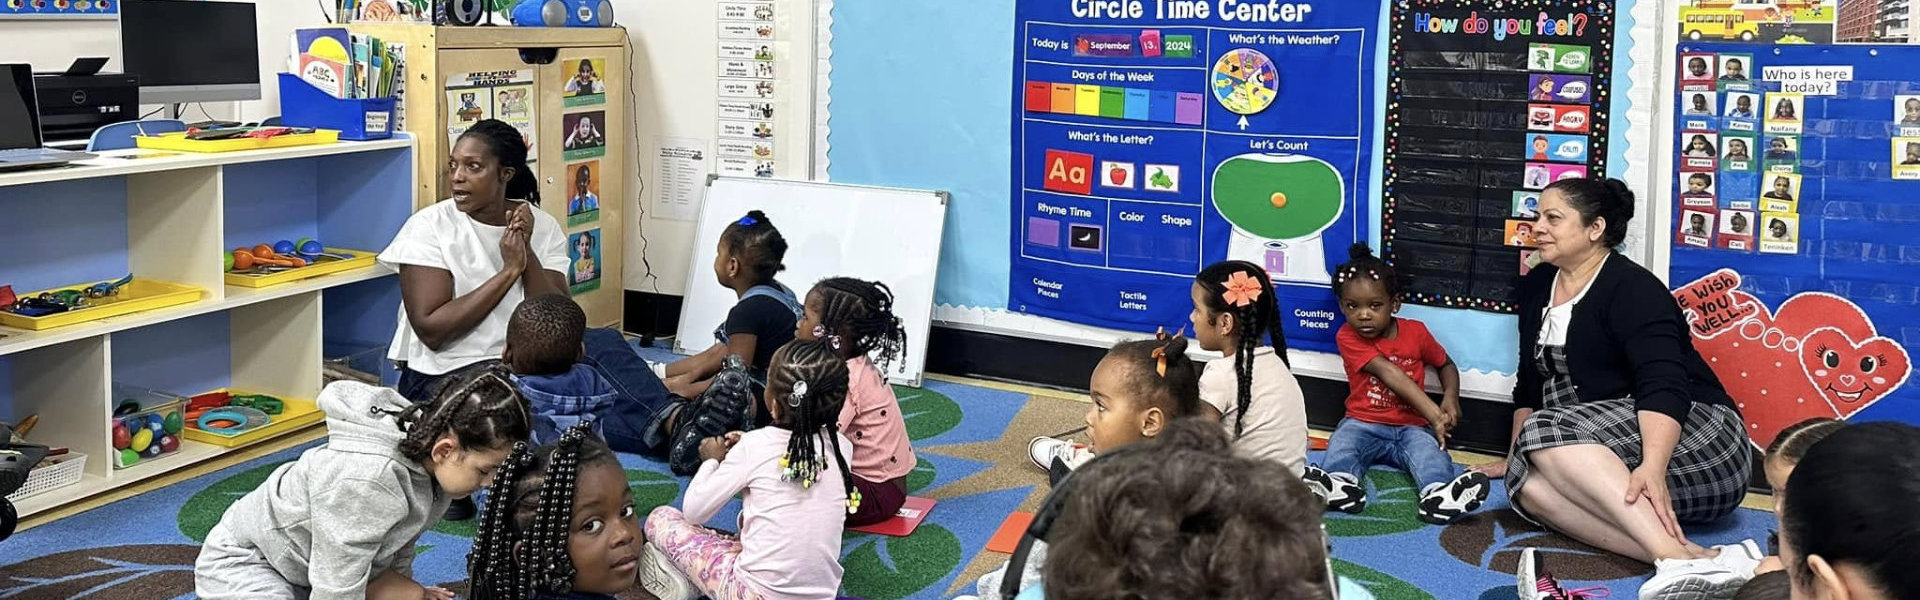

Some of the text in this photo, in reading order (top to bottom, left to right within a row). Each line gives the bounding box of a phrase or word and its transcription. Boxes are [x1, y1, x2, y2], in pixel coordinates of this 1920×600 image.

[1071, 0, 1312, 22] Circle Time Center
[1415, 11, 1588, 41] How do you feel?
[1032, 38, 1059, 51] Today
[1061, 40, 1069, 49] is
[1090, 41, 1131, 51] September
[1165, 41, 1191, 50] 2024
[1229, 34, 1340, 45] What's the Weather?
[468, 70, 517, 78] HELPING
[1072, 70, 1154, 82] Days of the Week
[1764, 68, 1848, 80] Who is here
[473, 78, 511, 86] HANDS
[1785, 82, 1832, 94] today?
[1068, 131, 1154, 145] What's the Letter?
[1903, 128, 1920, 136] Jes
[1250, 139, 1309, 151] Let's Count
[1048, 157, 1086, 185] Aa
[1037, 202, 1092, 218] Rhyme Time
[1119, 211, 1145, 222] Color
[1161, 214, 1192, 227] Shape
[1033, 277, 1063, 290] Calendar
[1037, 287, 1059, 299] Pieces
[1120, 291, 1147, 301] Tactile
[1119, 301, 1147, 311] Letters
[1678, 294, 1689, 308] E
[1294, 308, 1335, 321] Counting
[1300, 319, 1329, 329] Pieces
